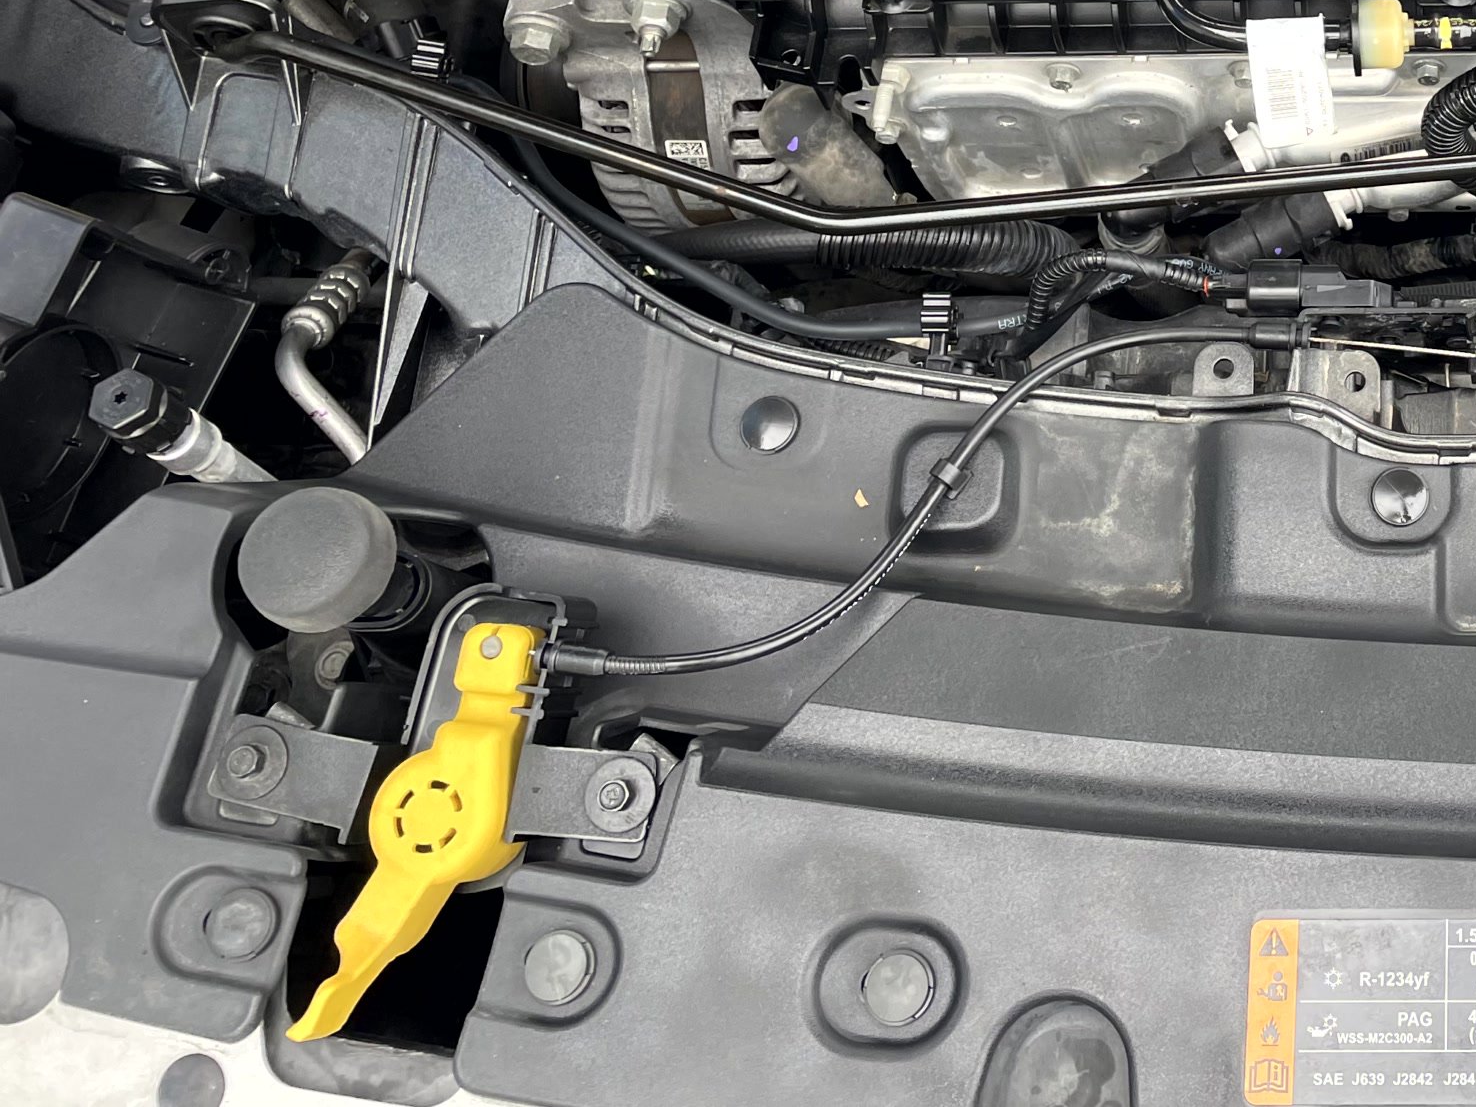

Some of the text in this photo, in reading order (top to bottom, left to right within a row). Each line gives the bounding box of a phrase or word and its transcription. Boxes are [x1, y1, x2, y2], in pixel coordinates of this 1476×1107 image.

[1359, 971, 1430, 990] R-1234yf
[1397, 1012, 1433, 1026] PAG
[1337, 1032, 1433, 1044] WSS-M2C300-A2
[1313, 1072, 1344, 1085] SAE
[1351, 1072, 1385, 1085] J639
[1392, 1072, 1433, 1085] J2842
